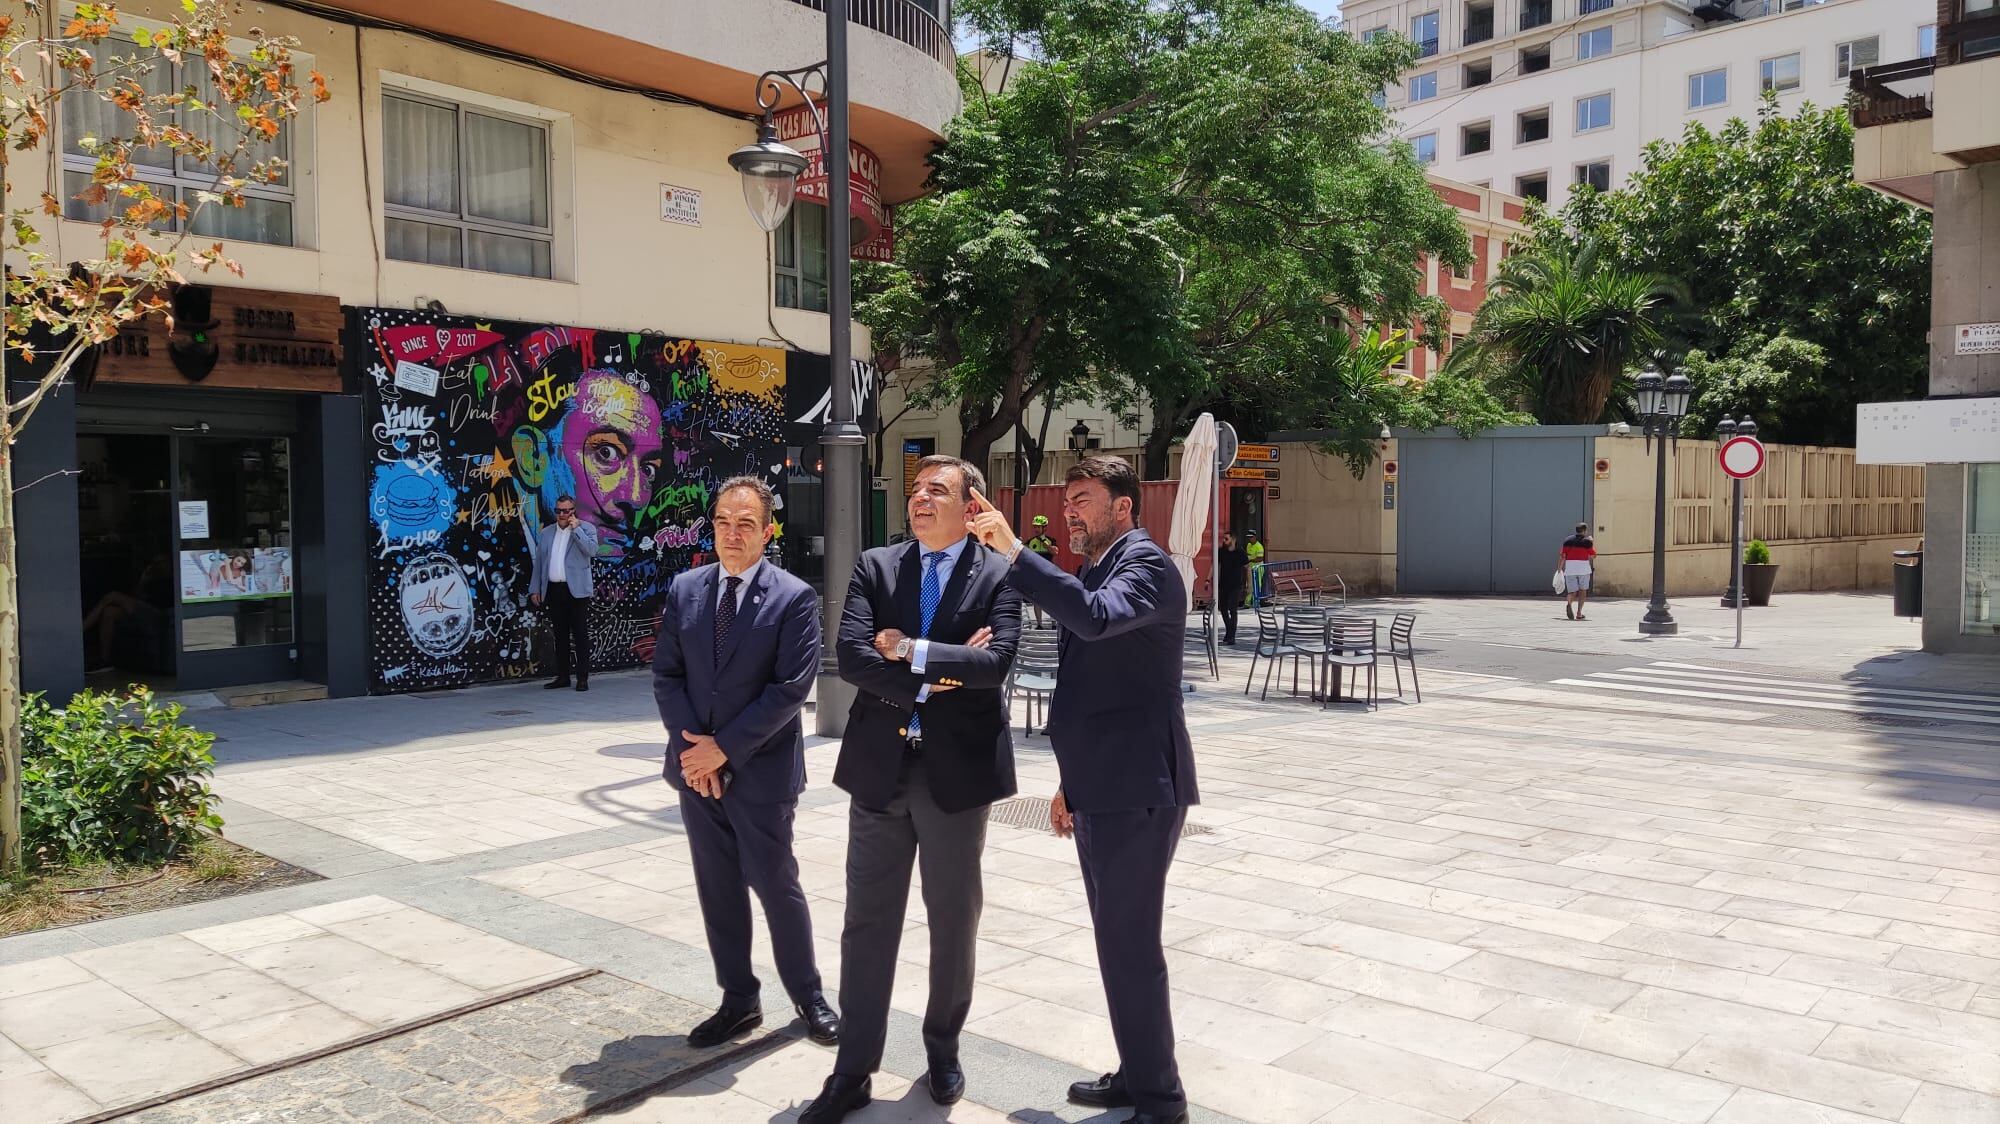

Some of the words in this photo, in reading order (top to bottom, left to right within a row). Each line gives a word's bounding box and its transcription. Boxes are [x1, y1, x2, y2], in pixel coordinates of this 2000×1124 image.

[401, 335, 429, 353] SINCE
[456, 333, 477, 347] 2017
[440, 352, 480, 390] Eat
[450, 393, 501, 433] Drink
[456, 453, 508, 487] Tattoo
[873, 480, 882, 488] 60
[471, 492, 530, 532] Repeat
[375, 521, 442, 559] Love
